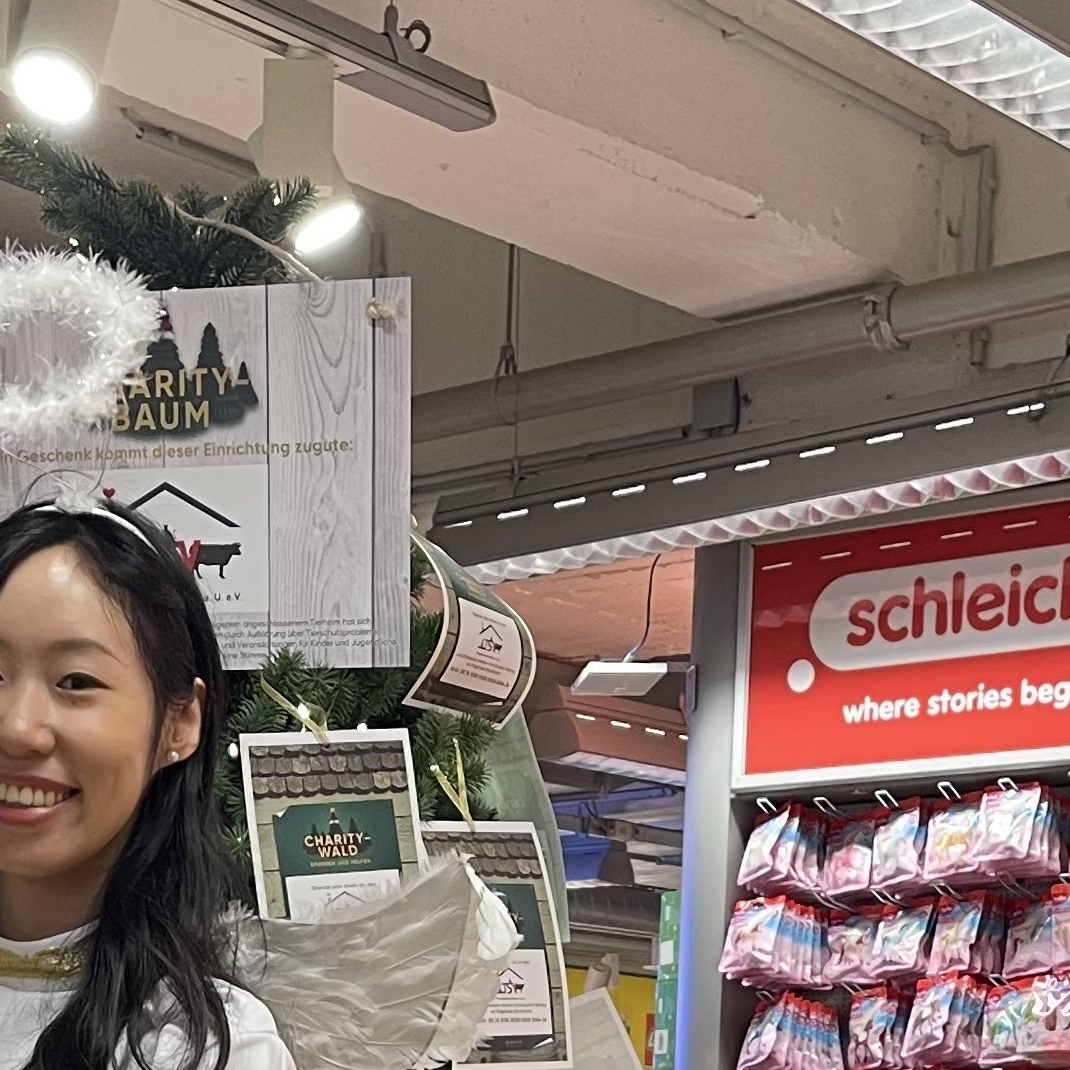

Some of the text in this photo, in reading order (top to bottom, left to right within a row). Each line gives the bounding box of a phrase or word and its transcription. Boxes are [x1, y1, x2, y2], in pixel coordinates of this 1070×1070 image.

[116, 365, 249, 398] ARITY-
[112, 400, 210, 432] BAUM
[17, 448, 91, 463] Geschenk
[95, 446, 148, 461] kommt
[152, 443, 199, 458] dieser
[204, 440, 290, 457] Einrichtung
[295, 438, 353, 455] zugute:
[842, 696, 920, 724] where
[927, 683, 1013, 717] stories
[304, 831, 371, 847] CHARITY-
[317, 844, 358, 858] WALD
